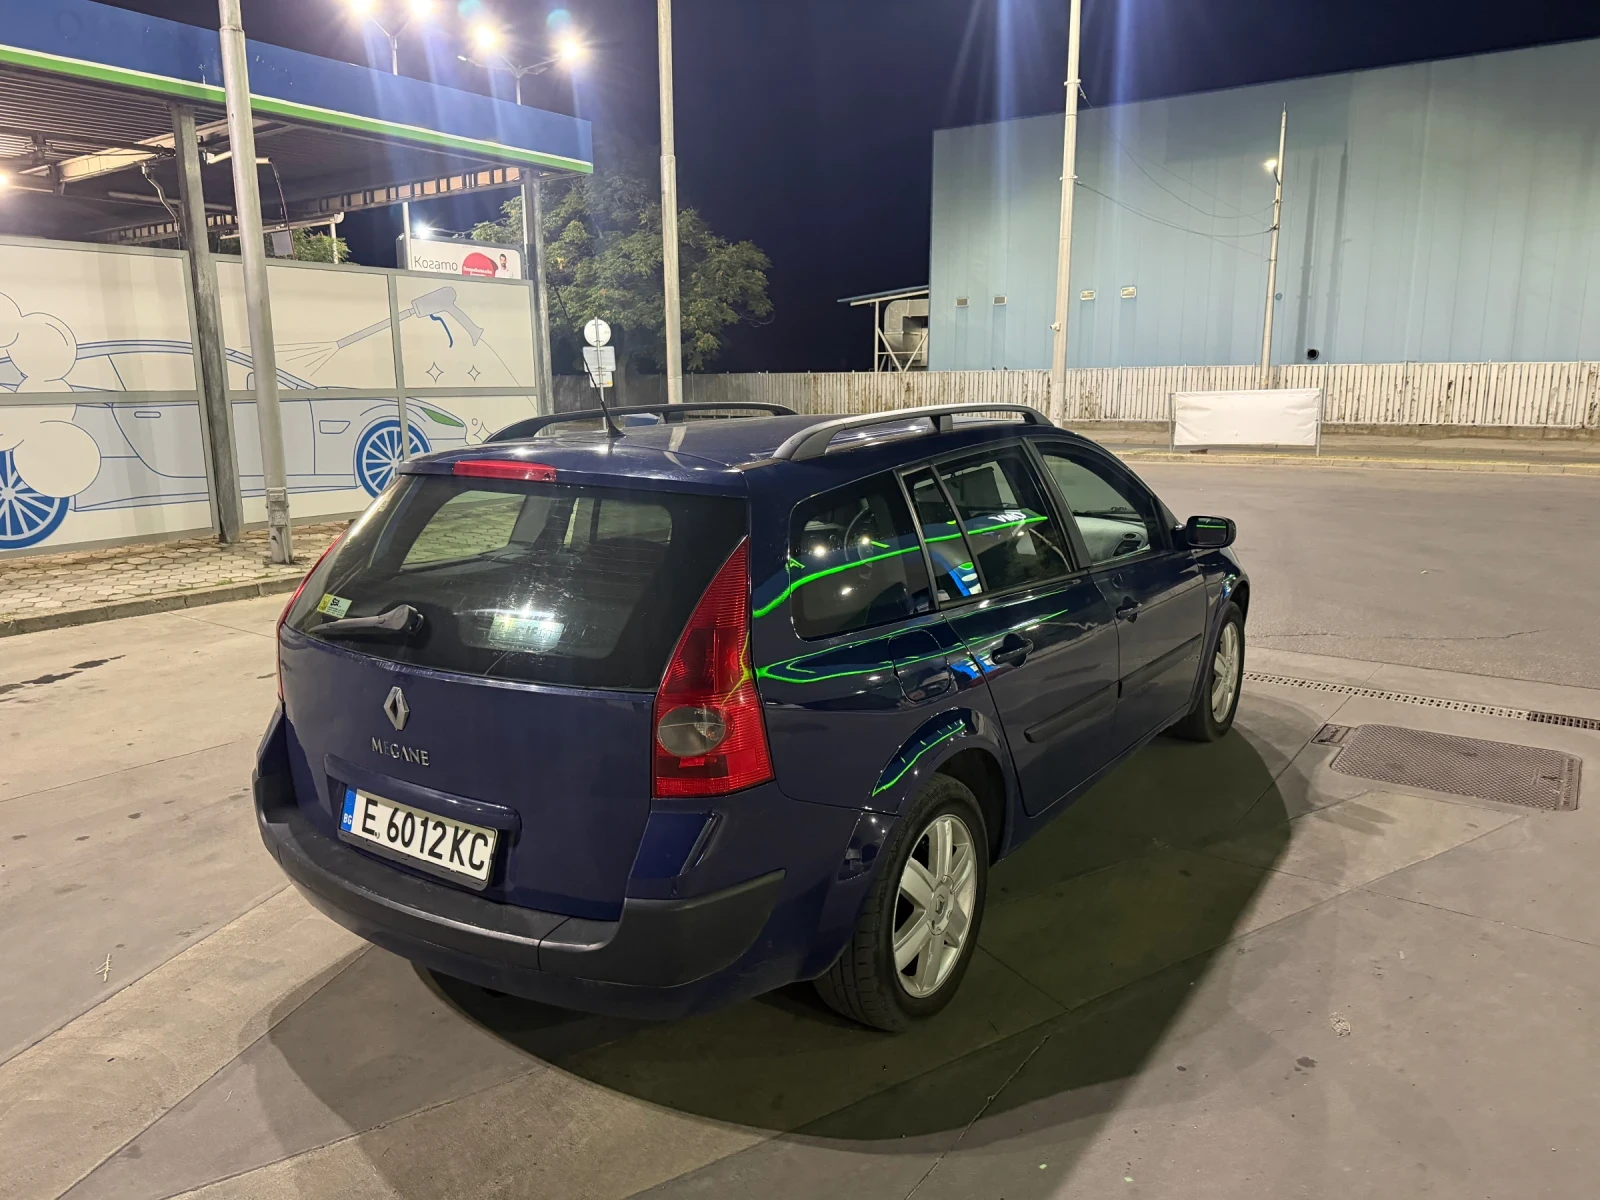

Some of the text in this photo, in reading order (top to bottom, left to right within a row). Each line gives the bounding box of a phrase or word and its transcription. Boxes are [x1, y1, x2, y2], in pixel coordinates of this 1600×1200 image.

[414, 256, 458, 271] Когато
[371, 736, 430, 766] MEGANE
[343, 813, 352, 825] BG
